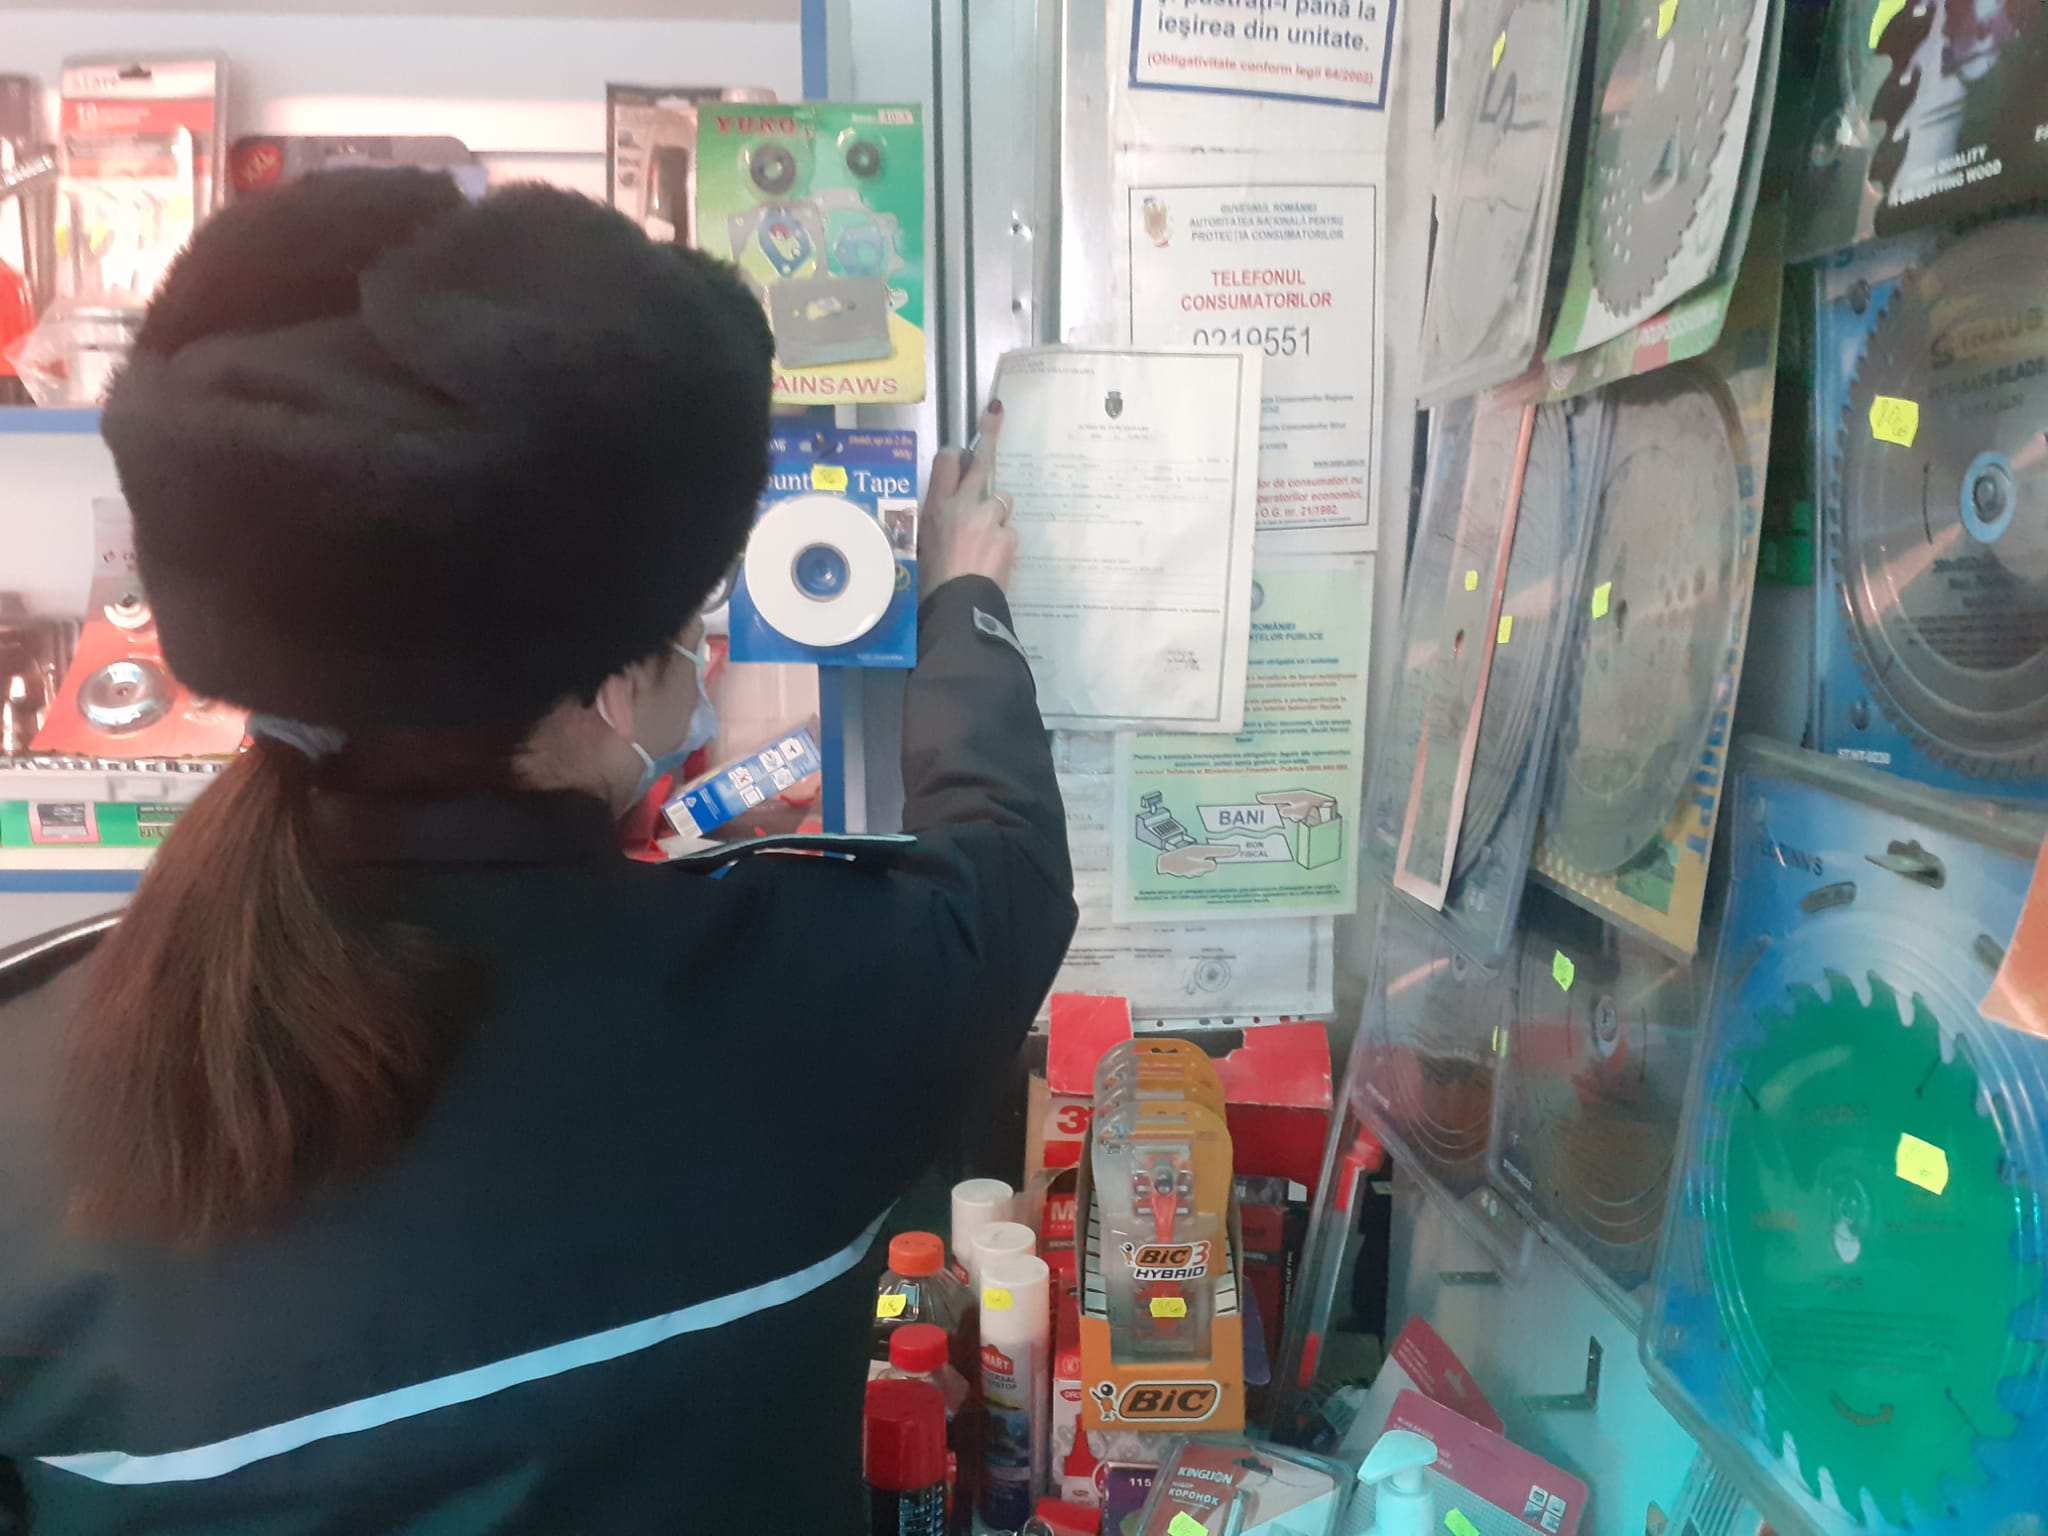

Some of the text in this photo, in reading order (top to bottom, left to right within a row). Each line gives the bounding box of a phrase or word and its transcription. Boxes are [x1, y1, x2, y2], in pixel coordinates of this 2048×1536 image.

[1358, 0, 1376, 21] la
[1243, 18, 1279, 42] din
[1287, 25, 1370, 51] unitate.
[1146, 52, 1237, 71] (Obligativitate
[1240, 60, 1293, 76] conform
[1966, 157, 2003, 185] WOOD
[1189, 216, 1255, 228] AUTORITATEA
[1308, 215, 1344, 227] PENTRU
[1252, 229, 1344, 242] CONSUMATORILOR
[1211, 268, 1306, 287] TELEFONUL
[1181, 292, 1332, 312] CONSUMATORILOR
[772, 375, 899, 396] AINSAWS
[853, 469, 912, 500] Tape
[1219, 809, 1265, 825] BANI
[1245, 841, 1264, 849] BON
[1191, 1242, 1212, 1267] 3
[1134, 1265, 1206, 1280] HYBRID
[1126, 1388, 1213, 1413] BIC
[1177, 1466, 1233, 1486] KINGLION
[1168, 1487, 1220, 1506] КОРОНОК
